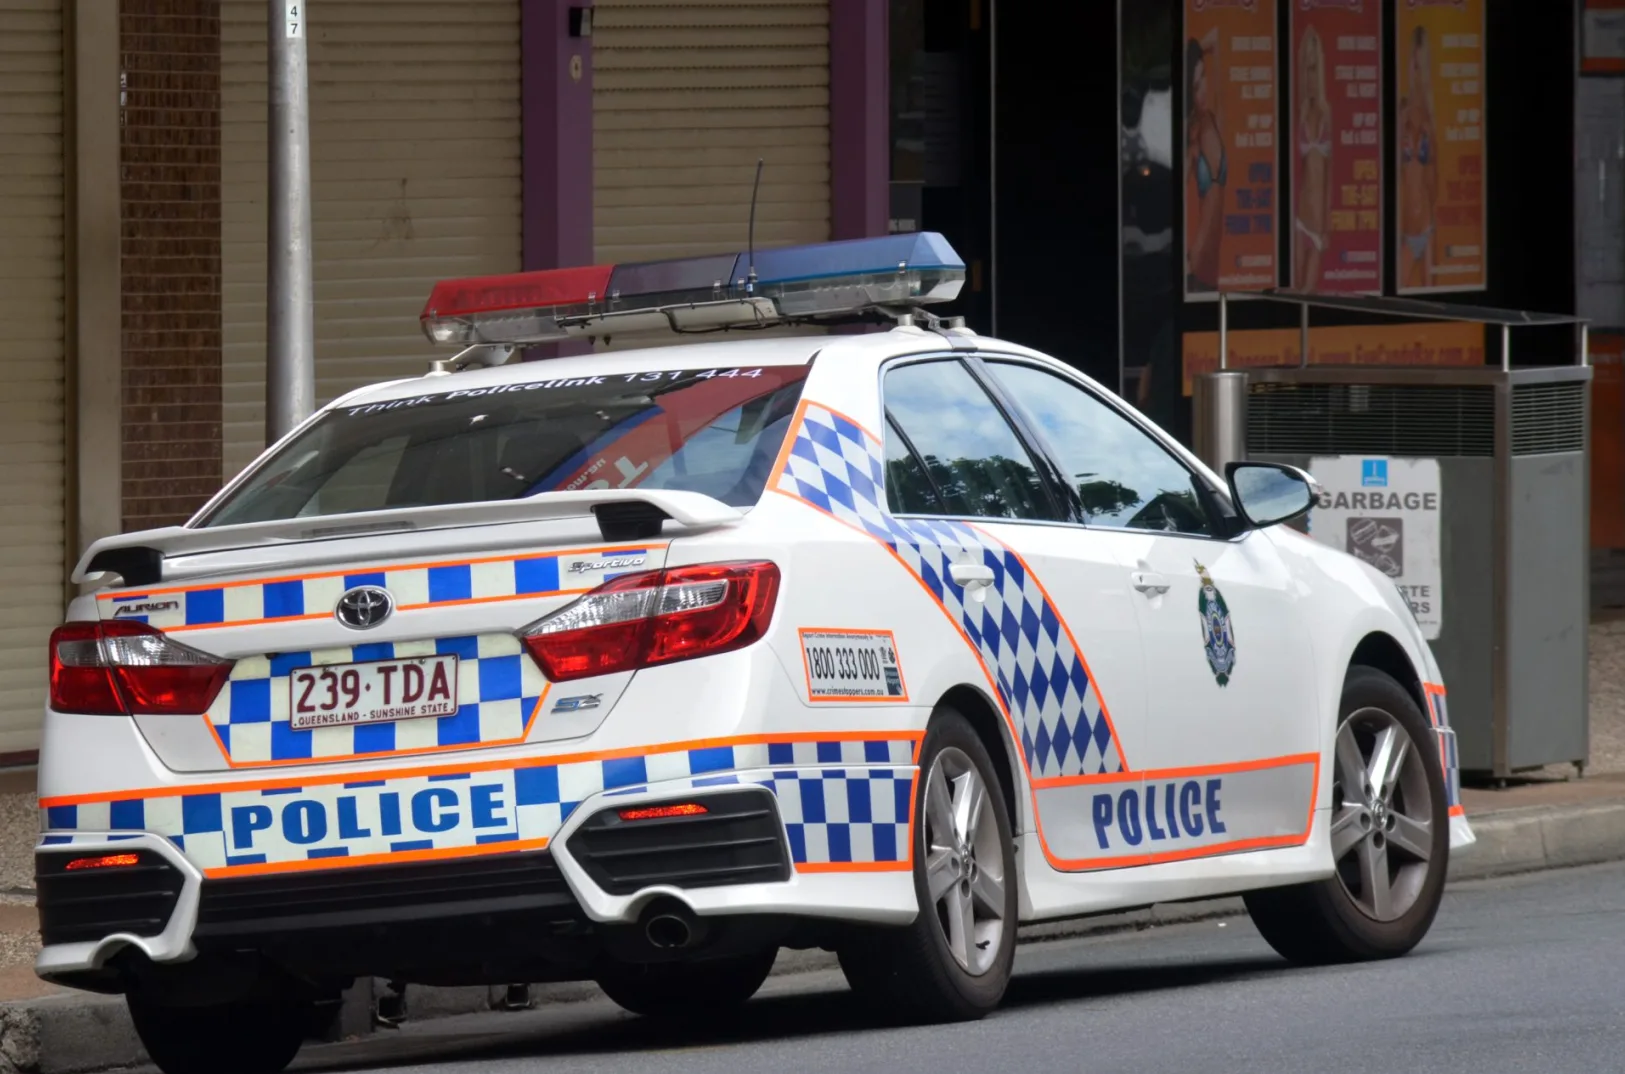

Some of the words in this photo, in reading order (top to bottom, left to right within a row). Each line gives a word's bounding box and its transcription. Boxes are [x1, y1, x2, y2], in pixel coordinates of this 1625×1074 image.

[290, 5, 298, 17] 4
[290, 23, 298, 35] 7
[348, 394, 436, 416] Think
[445, 374, 608, 400] Policelink
[623, 370, 683, 383] 131
[695, 368, 764, 379] 444
[1317, 491, 1437, 511] GARBAGE
[568, 556, 646, 574] Sportivo
[114, 601, 179, 616] AURION
[806, 646, 835, 680] 1800
[836, 646, 858, 680] 333
[858, 647, 880, 680] 000
[298, 709, 360, 726] QUEENSLAND
[369, 706, 416, 720] SUNSHINE
[420, 702, 449, 715] STATE
[230, 783, 509, 850] POLICE
[1092, 779, 1227, 850] POLICE
